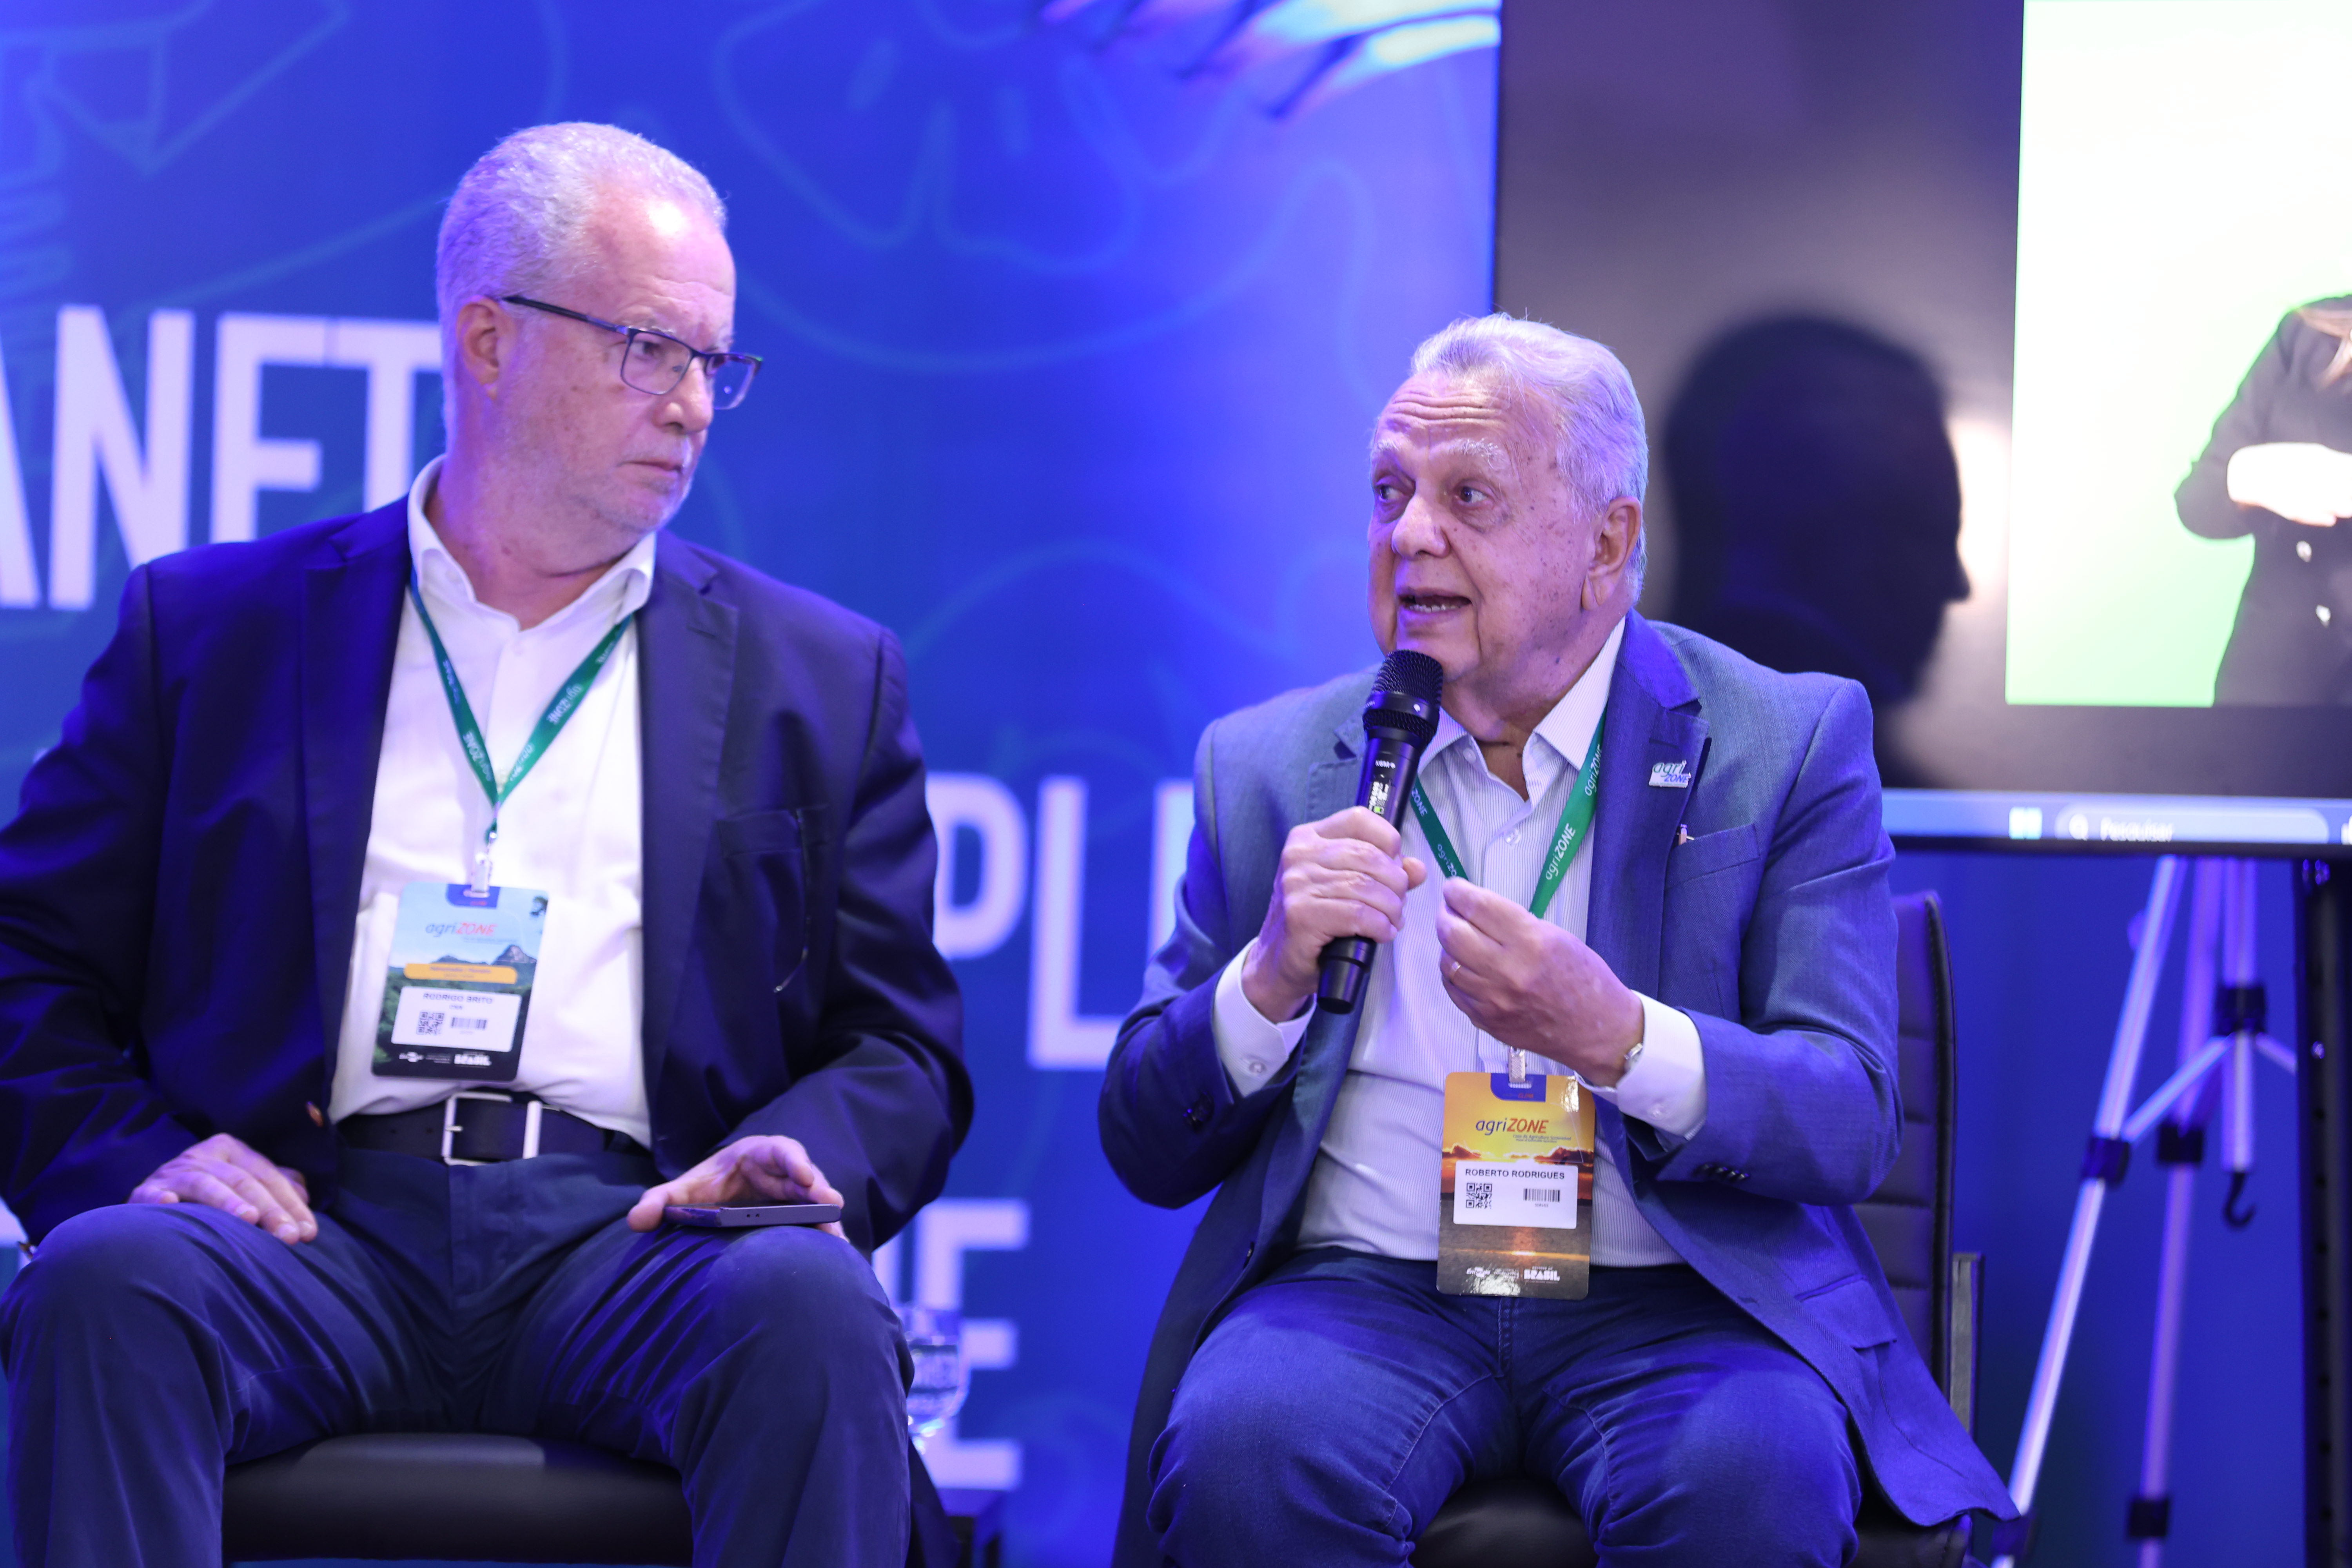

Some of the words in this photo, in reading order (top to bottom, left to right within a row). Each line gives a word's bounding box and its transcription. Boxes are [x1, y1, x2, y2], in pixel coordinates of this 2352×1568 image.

[0, 304, 443, 610] NET
[1653, 760, 1686, 777] agri
[1664, 773, 1689, 783] ZONE
[1546, 823, 1576, 880] agriZONE
[1437, 844, 1457, 877] agriZO
[926, 772, 1195, 1069] PL
[425, 922, 499, 938] agriZONE
[423, 993, 464, 1002] RODRIGO
[466, 996, 493, 1004] BRITO
[1475, 1118, 1549, 1136] agriZONE
[1512, 1171, 1565, 1179] RODRIGUES
[1524, 1269, 1560, 1281] BRASIL
